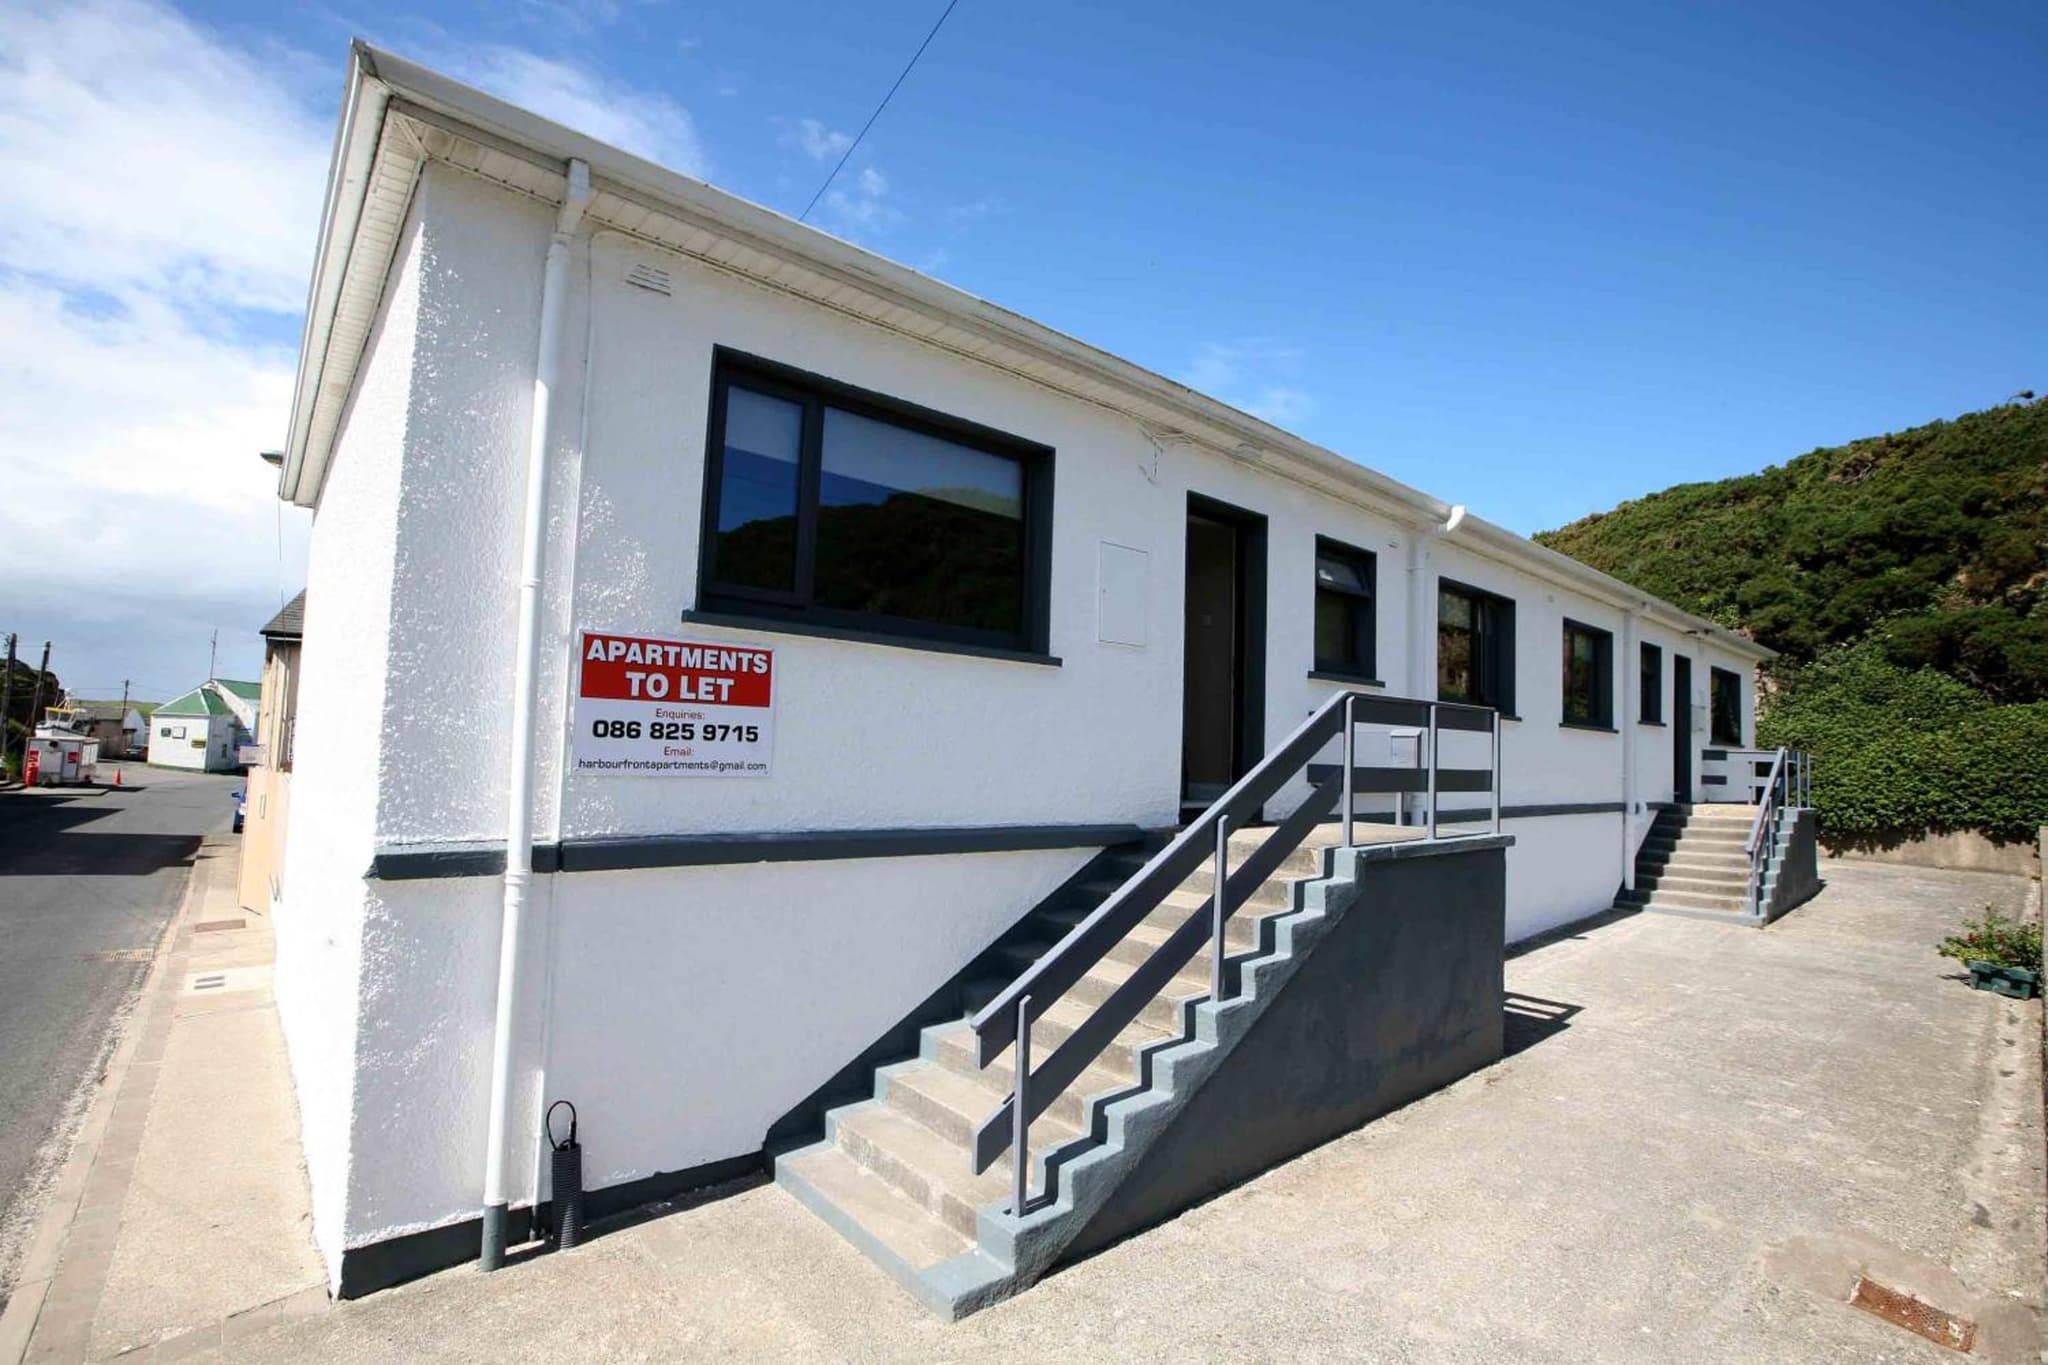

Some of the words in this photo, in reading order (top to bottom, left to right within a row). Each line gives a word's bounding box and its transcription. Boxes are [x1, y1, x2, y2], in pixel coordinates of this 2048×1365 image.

[587, 639, 768, 674] APARTMENTS
[625, 671, 669, 698] TO
[680, 675, 735, 702] LET
[656, 708, 705, 720] Enquiries:
[592, 720, 642, 739] 086
[650, 722, 695, 740] 825
[703, 724, 759, 742] 9715
[664, 746, 694, 757] Email:
[579, 758, 767, 772] harbourfrontapartments@gmailcom
